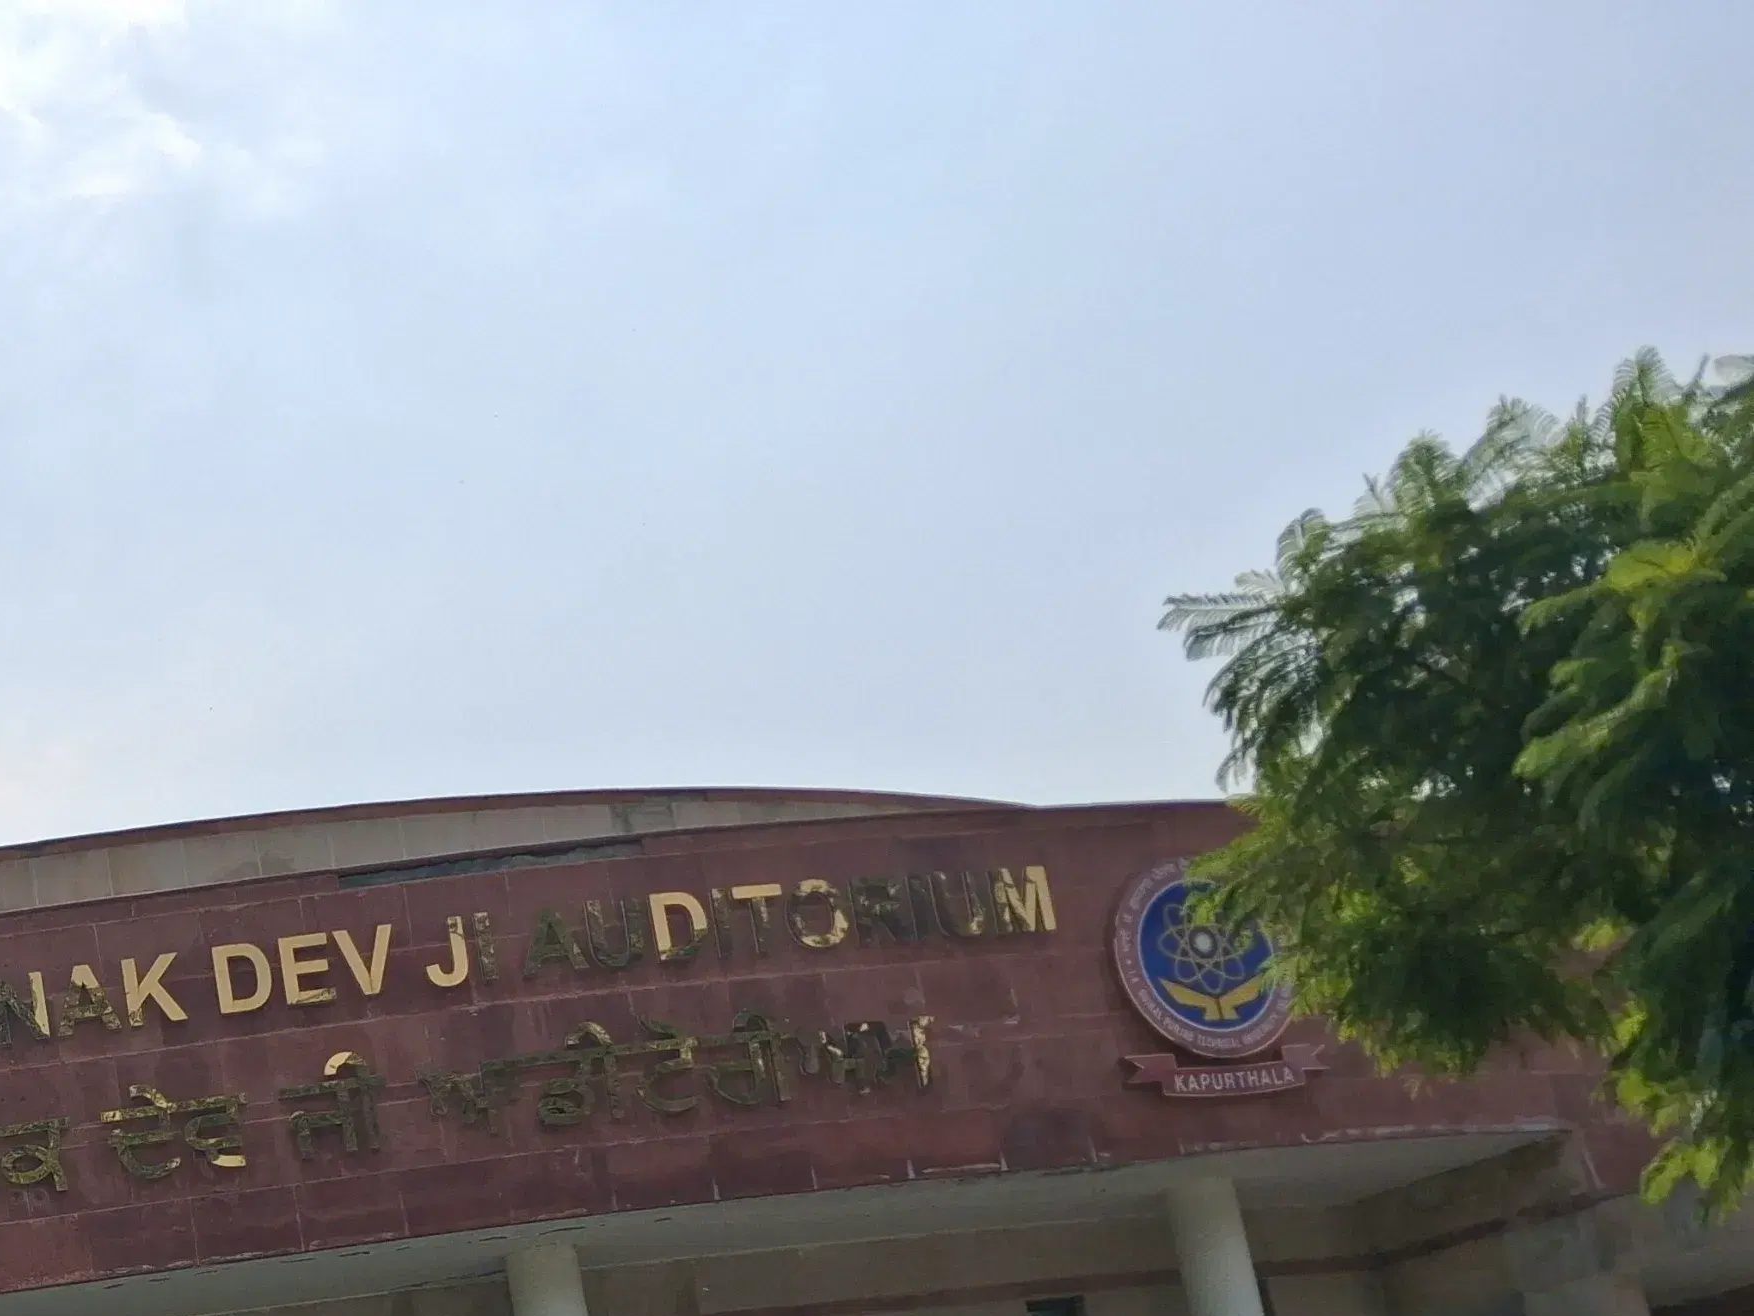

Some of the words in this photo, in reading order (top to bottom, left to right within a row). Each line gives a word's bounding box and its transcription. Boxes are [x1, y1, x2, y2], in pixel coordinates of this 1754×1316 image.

[211, 924, 392, 1015] DEV
[426, 911, 498, 987] JI
[523, 865, 1057, 977] AUDITORIUM
[1174, 1067, 1295, 1093] KAPURTHALA
